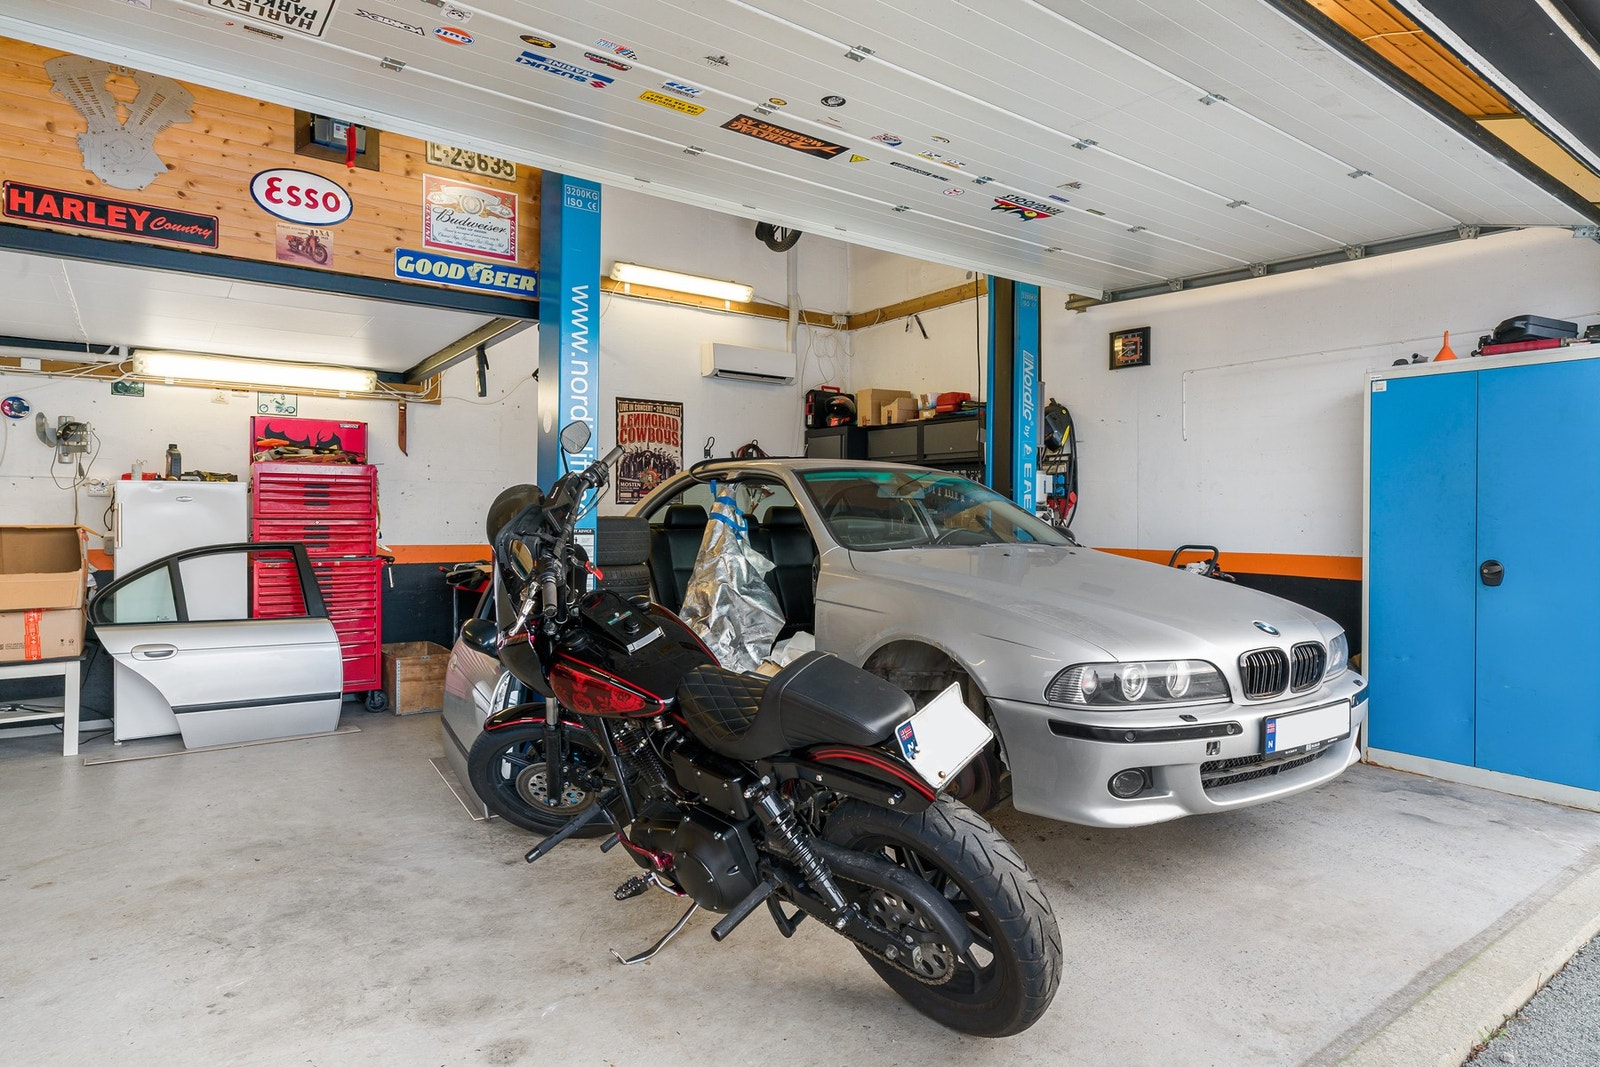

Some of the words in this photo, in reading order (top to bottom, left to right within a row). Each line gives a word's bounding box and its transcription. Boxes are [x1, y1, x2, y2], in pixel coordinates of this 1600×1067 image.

[223, 0, 313, 30] HARLEY
[254, 0, 317, 20] PARK
[435, 28, 473, 43] Gulf
[515, 57, 588, 82] SUZUKI
[546, 58, 594, 77] MARINE
[566, 186, 598, 201] 3200KG
[567, 197, 583, 208] ISO
[9, 188, 150, 231] HARLEY
[149, 216, 213, 239] Country
[433, 207, 507, 234] Budweiser
[397, 256, 465, 280] GOOD
[479, 269, 536, 291] BEER
[1023, 359, 1035, 421] Nordic
[620, 413, 679, 431] LENINGRAD
[1024, 425, 1031, 438] by
[619, 427, 680, 448] COWBOYS
[1024, 463, 1032, 509] EAE
[907, 741, 915, 751] N
[1267, 740, 1274, 748] N
